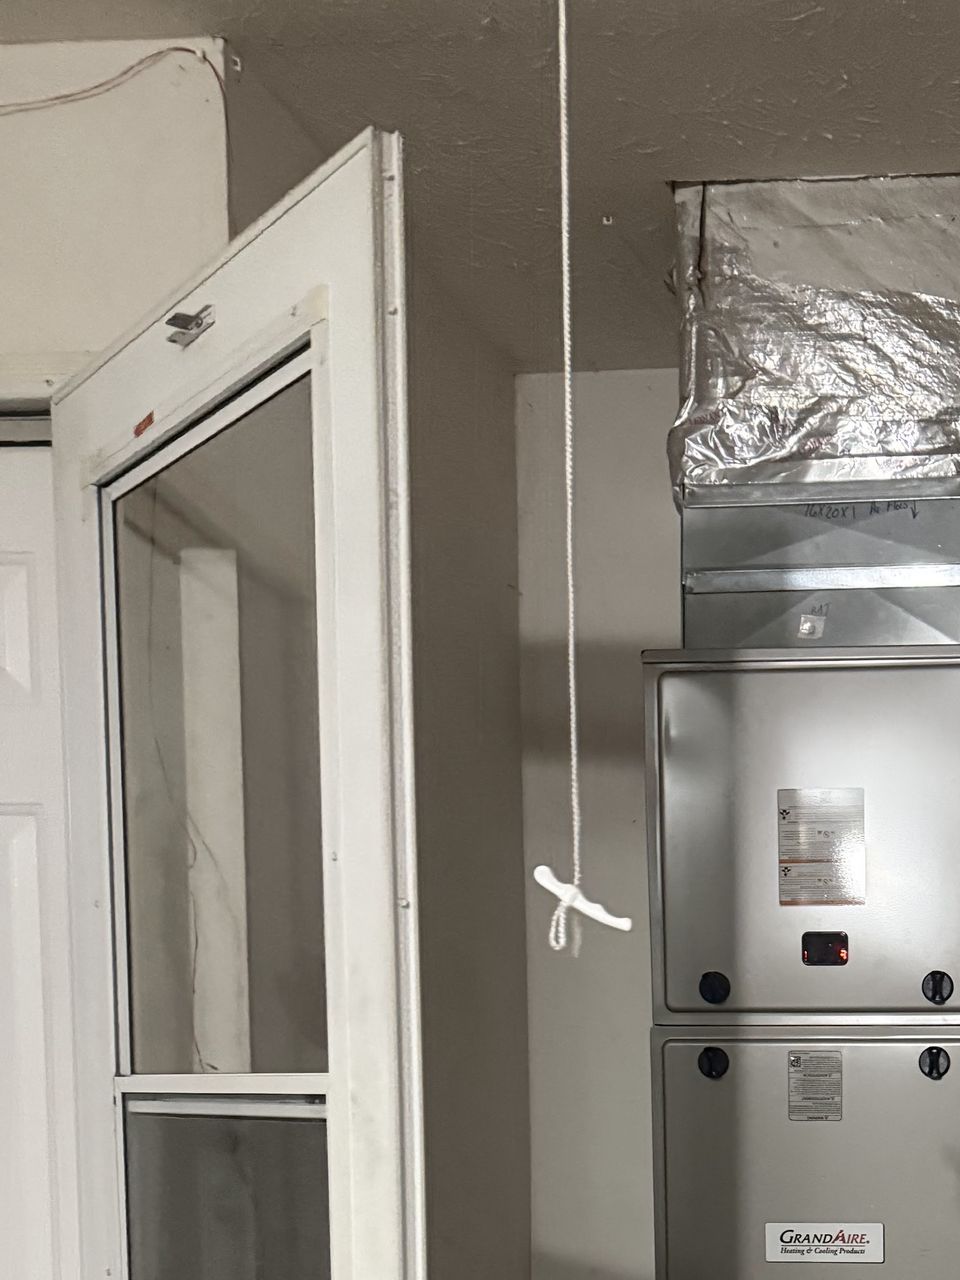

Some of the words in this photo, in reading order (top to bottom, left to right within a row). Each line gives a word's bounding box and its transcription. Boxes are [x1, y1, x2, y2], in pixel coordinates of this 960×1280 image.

[780, 1247, 805, 1256] Heating
[814, 1247, 838, 1256] Cooling
[839, 1247, 866, 1255] Products
